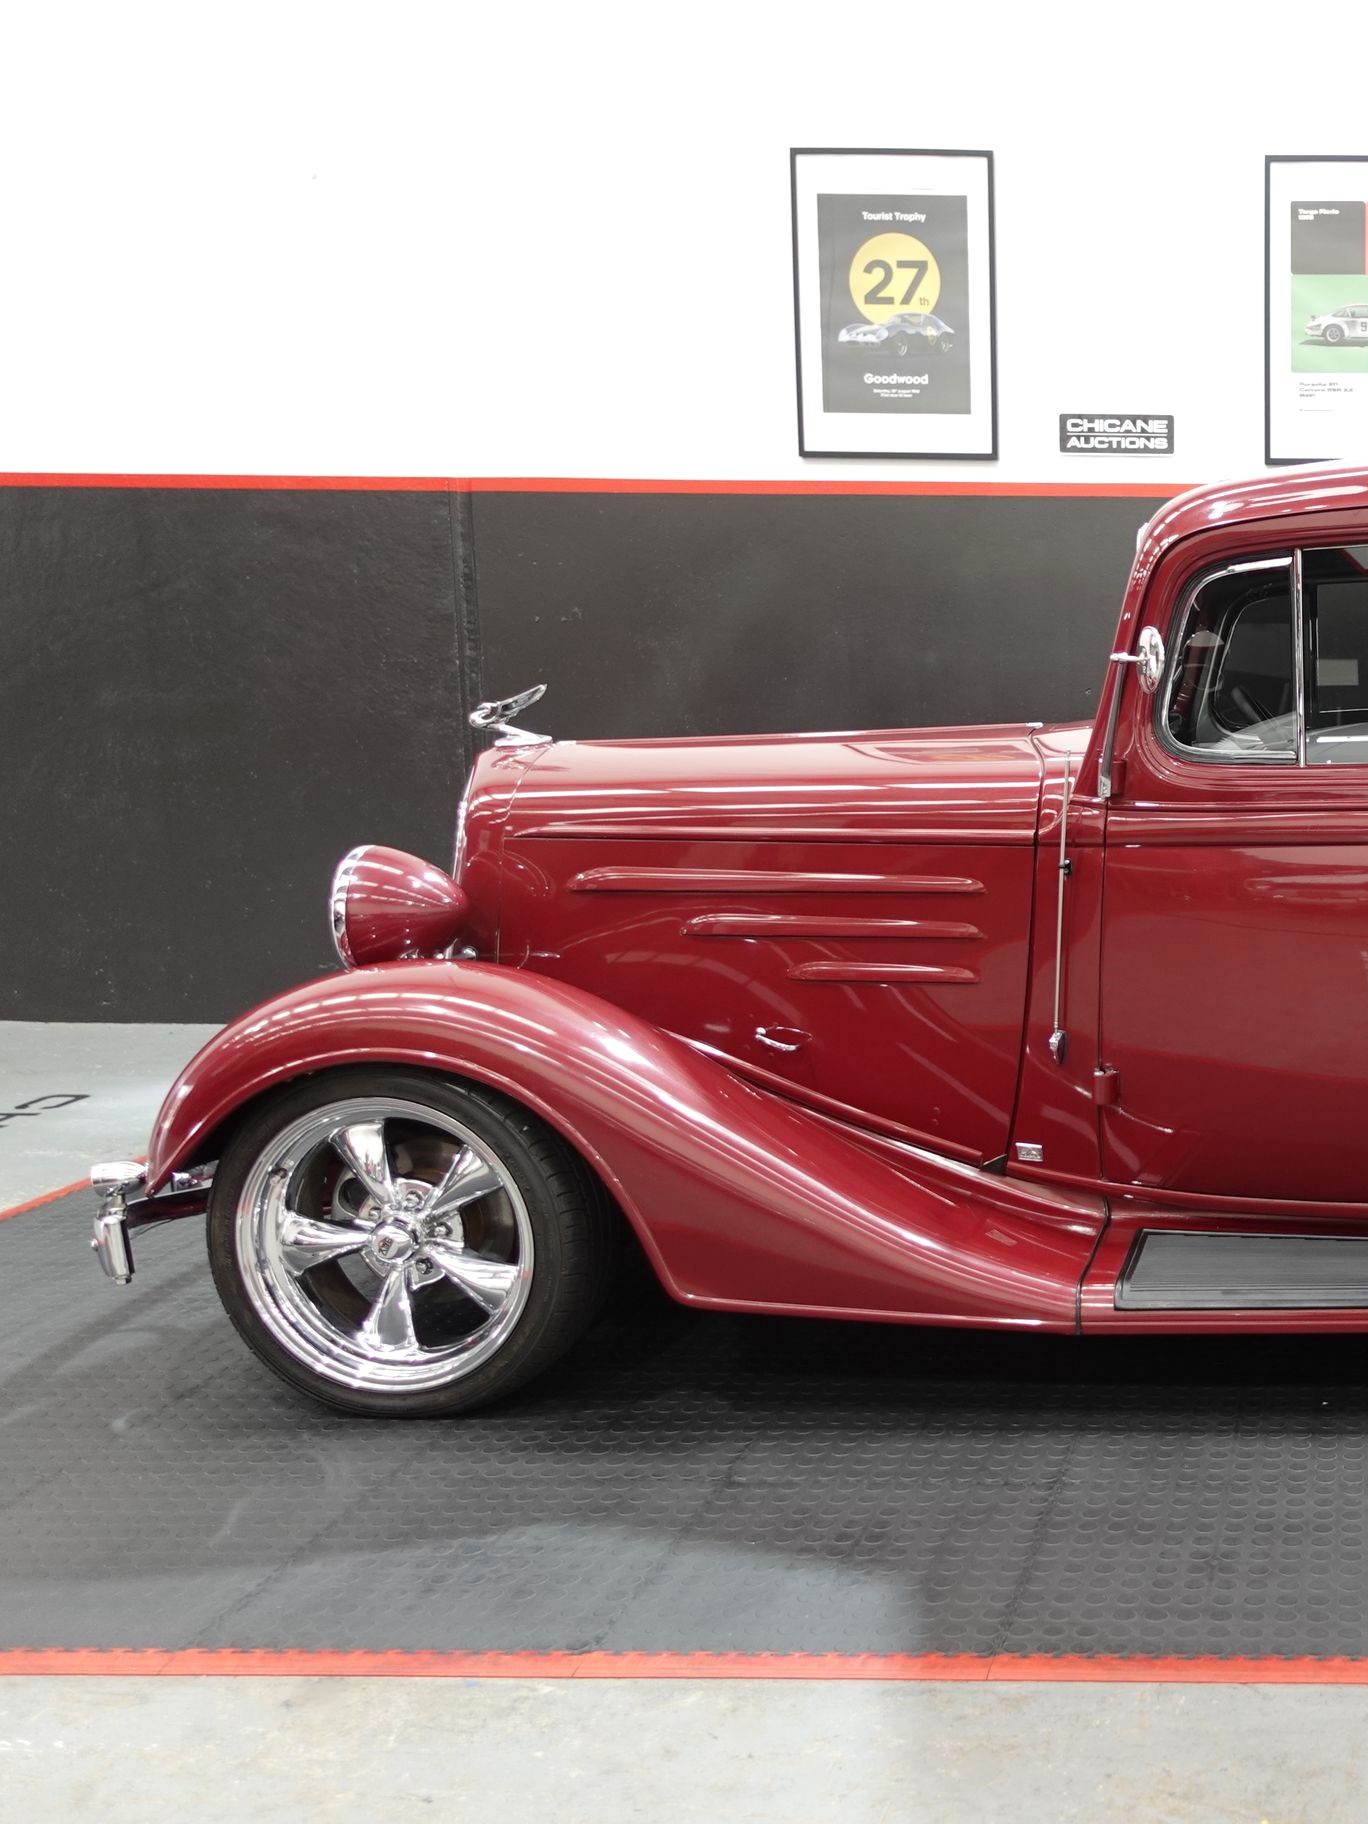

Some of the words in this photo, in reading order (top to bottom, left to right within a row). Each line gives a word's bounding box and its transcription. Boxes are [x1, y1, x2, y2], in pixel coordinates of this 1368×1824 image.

[862, 211, 893, 221] Tourist
[894, 211, 927, 223] Trophy
[1360, 321, 1368, 332] 9
[863, 373, 929, 385] Goodwood
[1066, 418, 1169, 433] CHICANE
[1066, 436, 1169, 449] AUCTIONS
